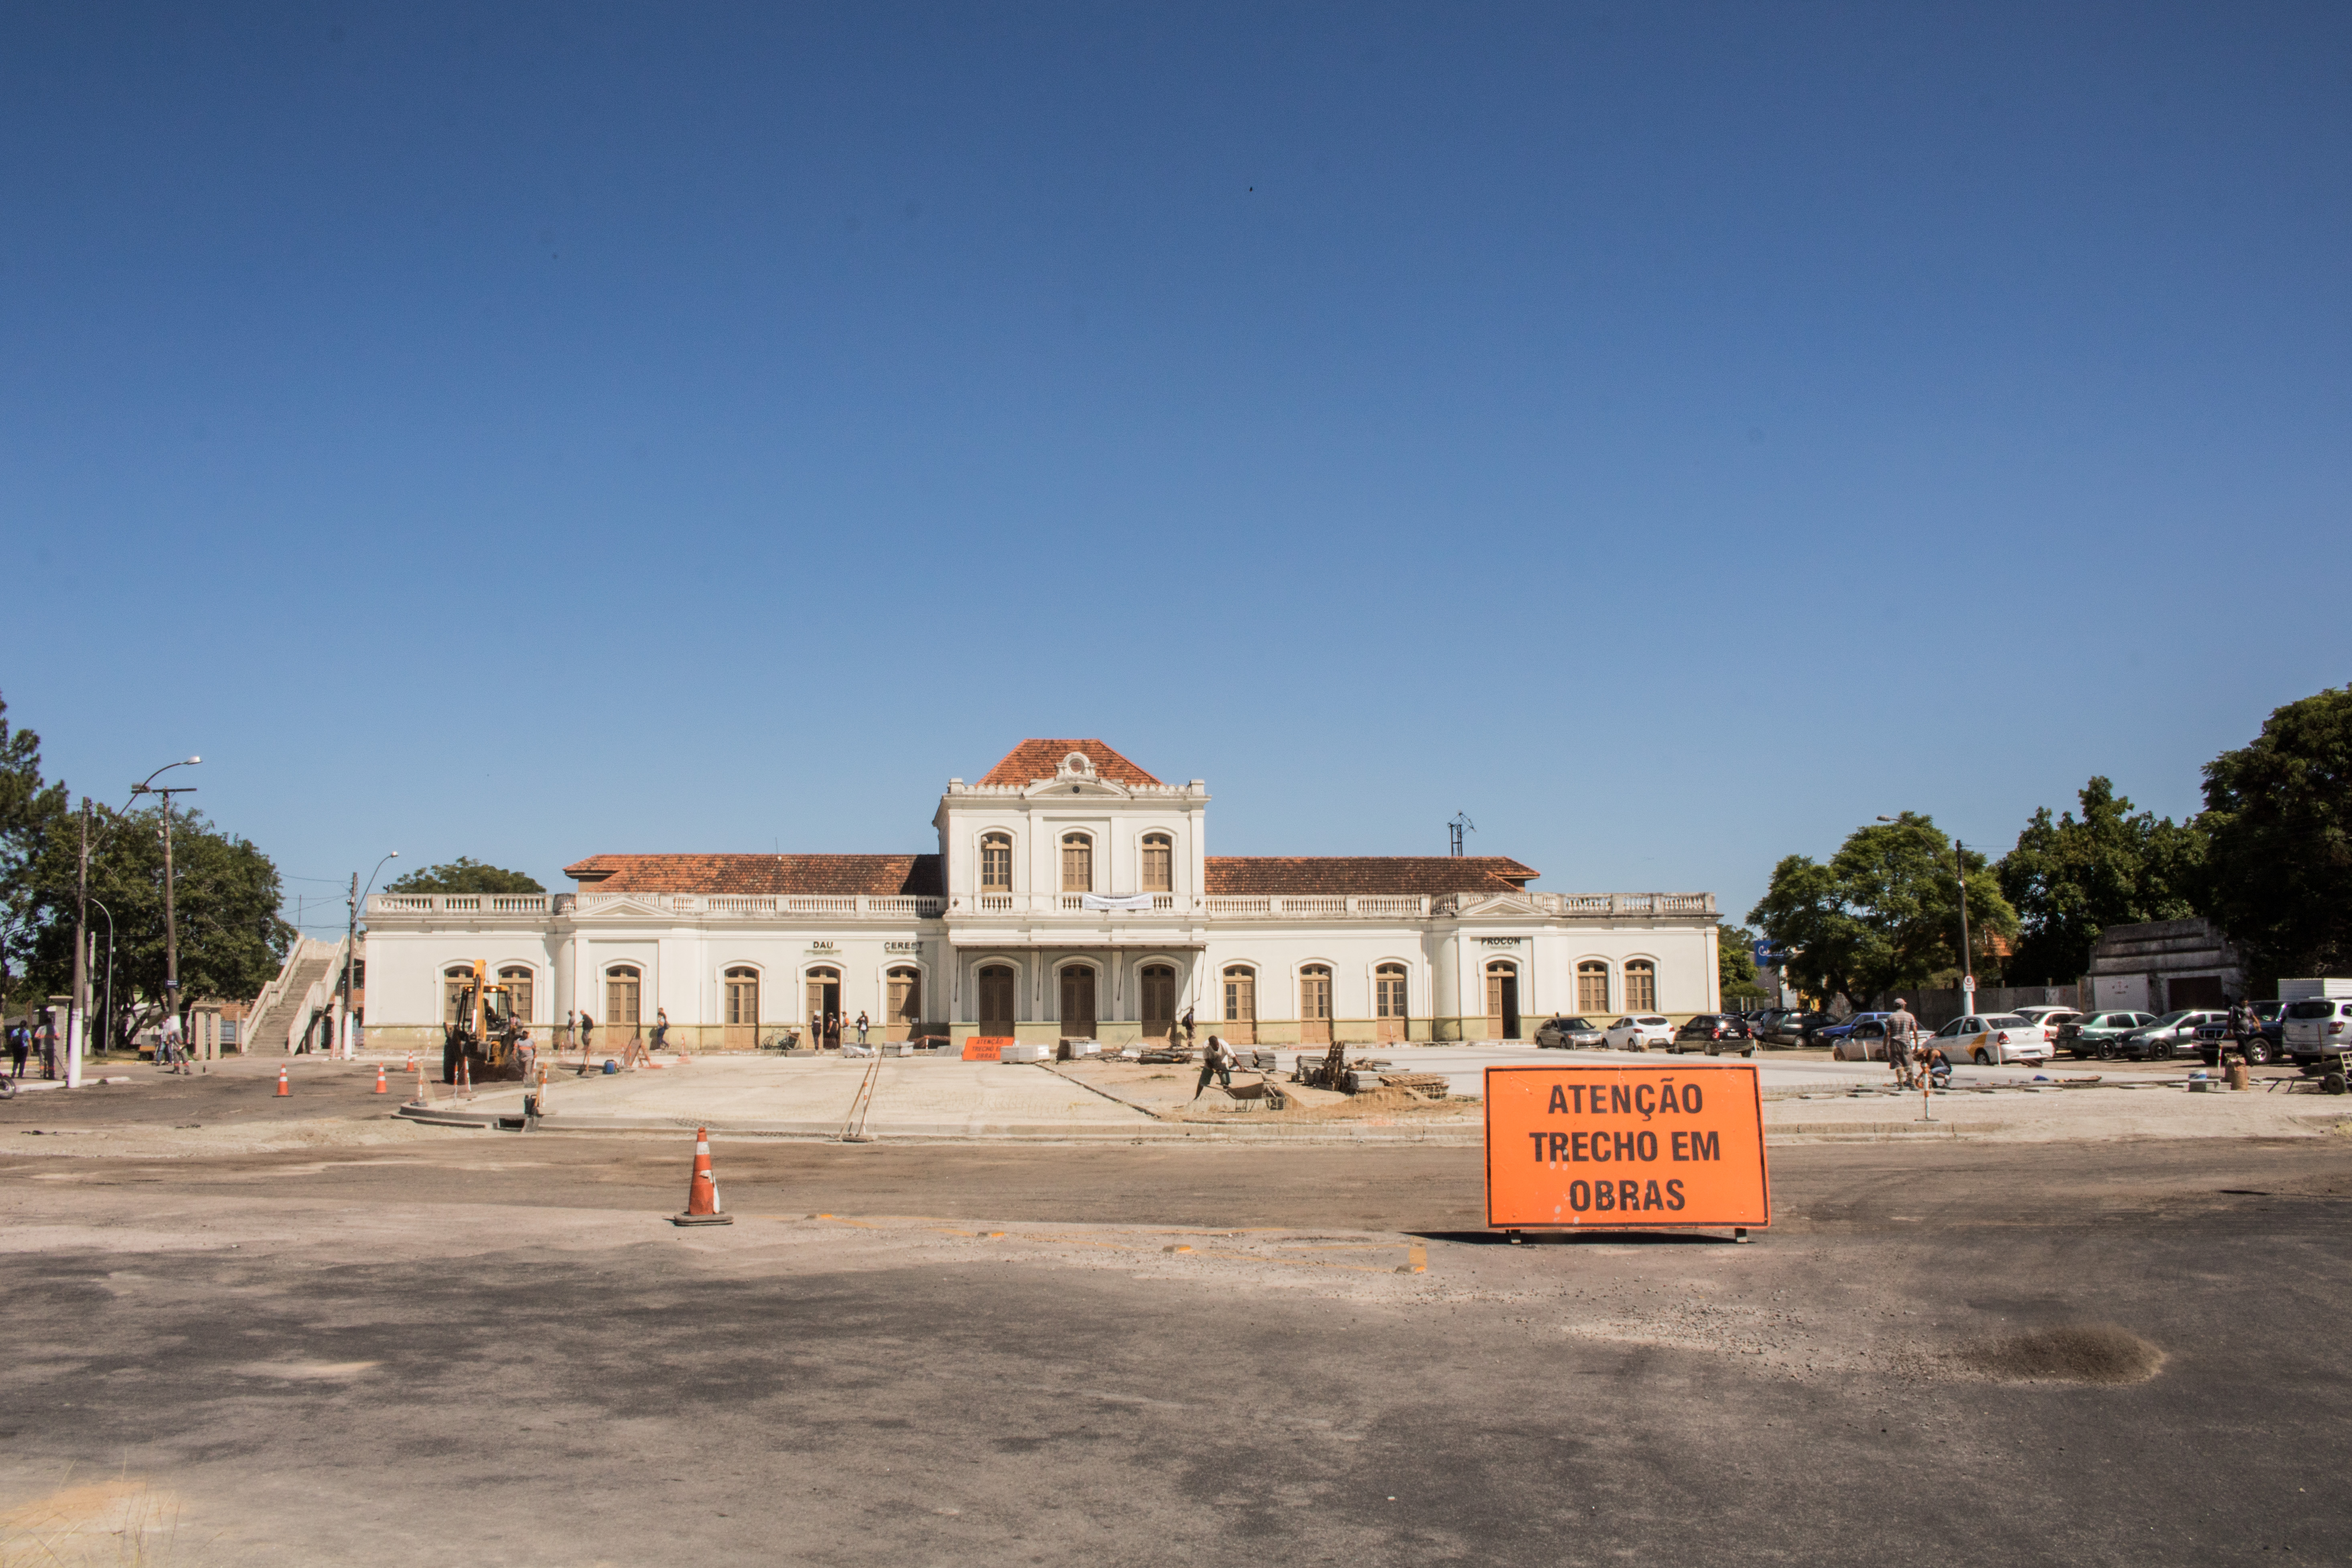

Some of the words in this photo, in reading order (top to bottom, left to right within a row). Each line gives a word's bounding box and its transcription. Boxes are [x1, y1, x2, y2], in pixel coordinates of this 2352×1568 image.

[884, 941, 924, 949] CEREST
[1481, 937, 1520, 945] PROCON
[976, 1037, 1004, 1045] ATENÇÃO
[1548, 1077, 1703, 1122] ATENÇÃO
[1529, 1131, 1658, 1162] TRECHO
[1671, 1131, 1720, 1161] EM
[1570, 1179, 1685, 1211] OBRAS
